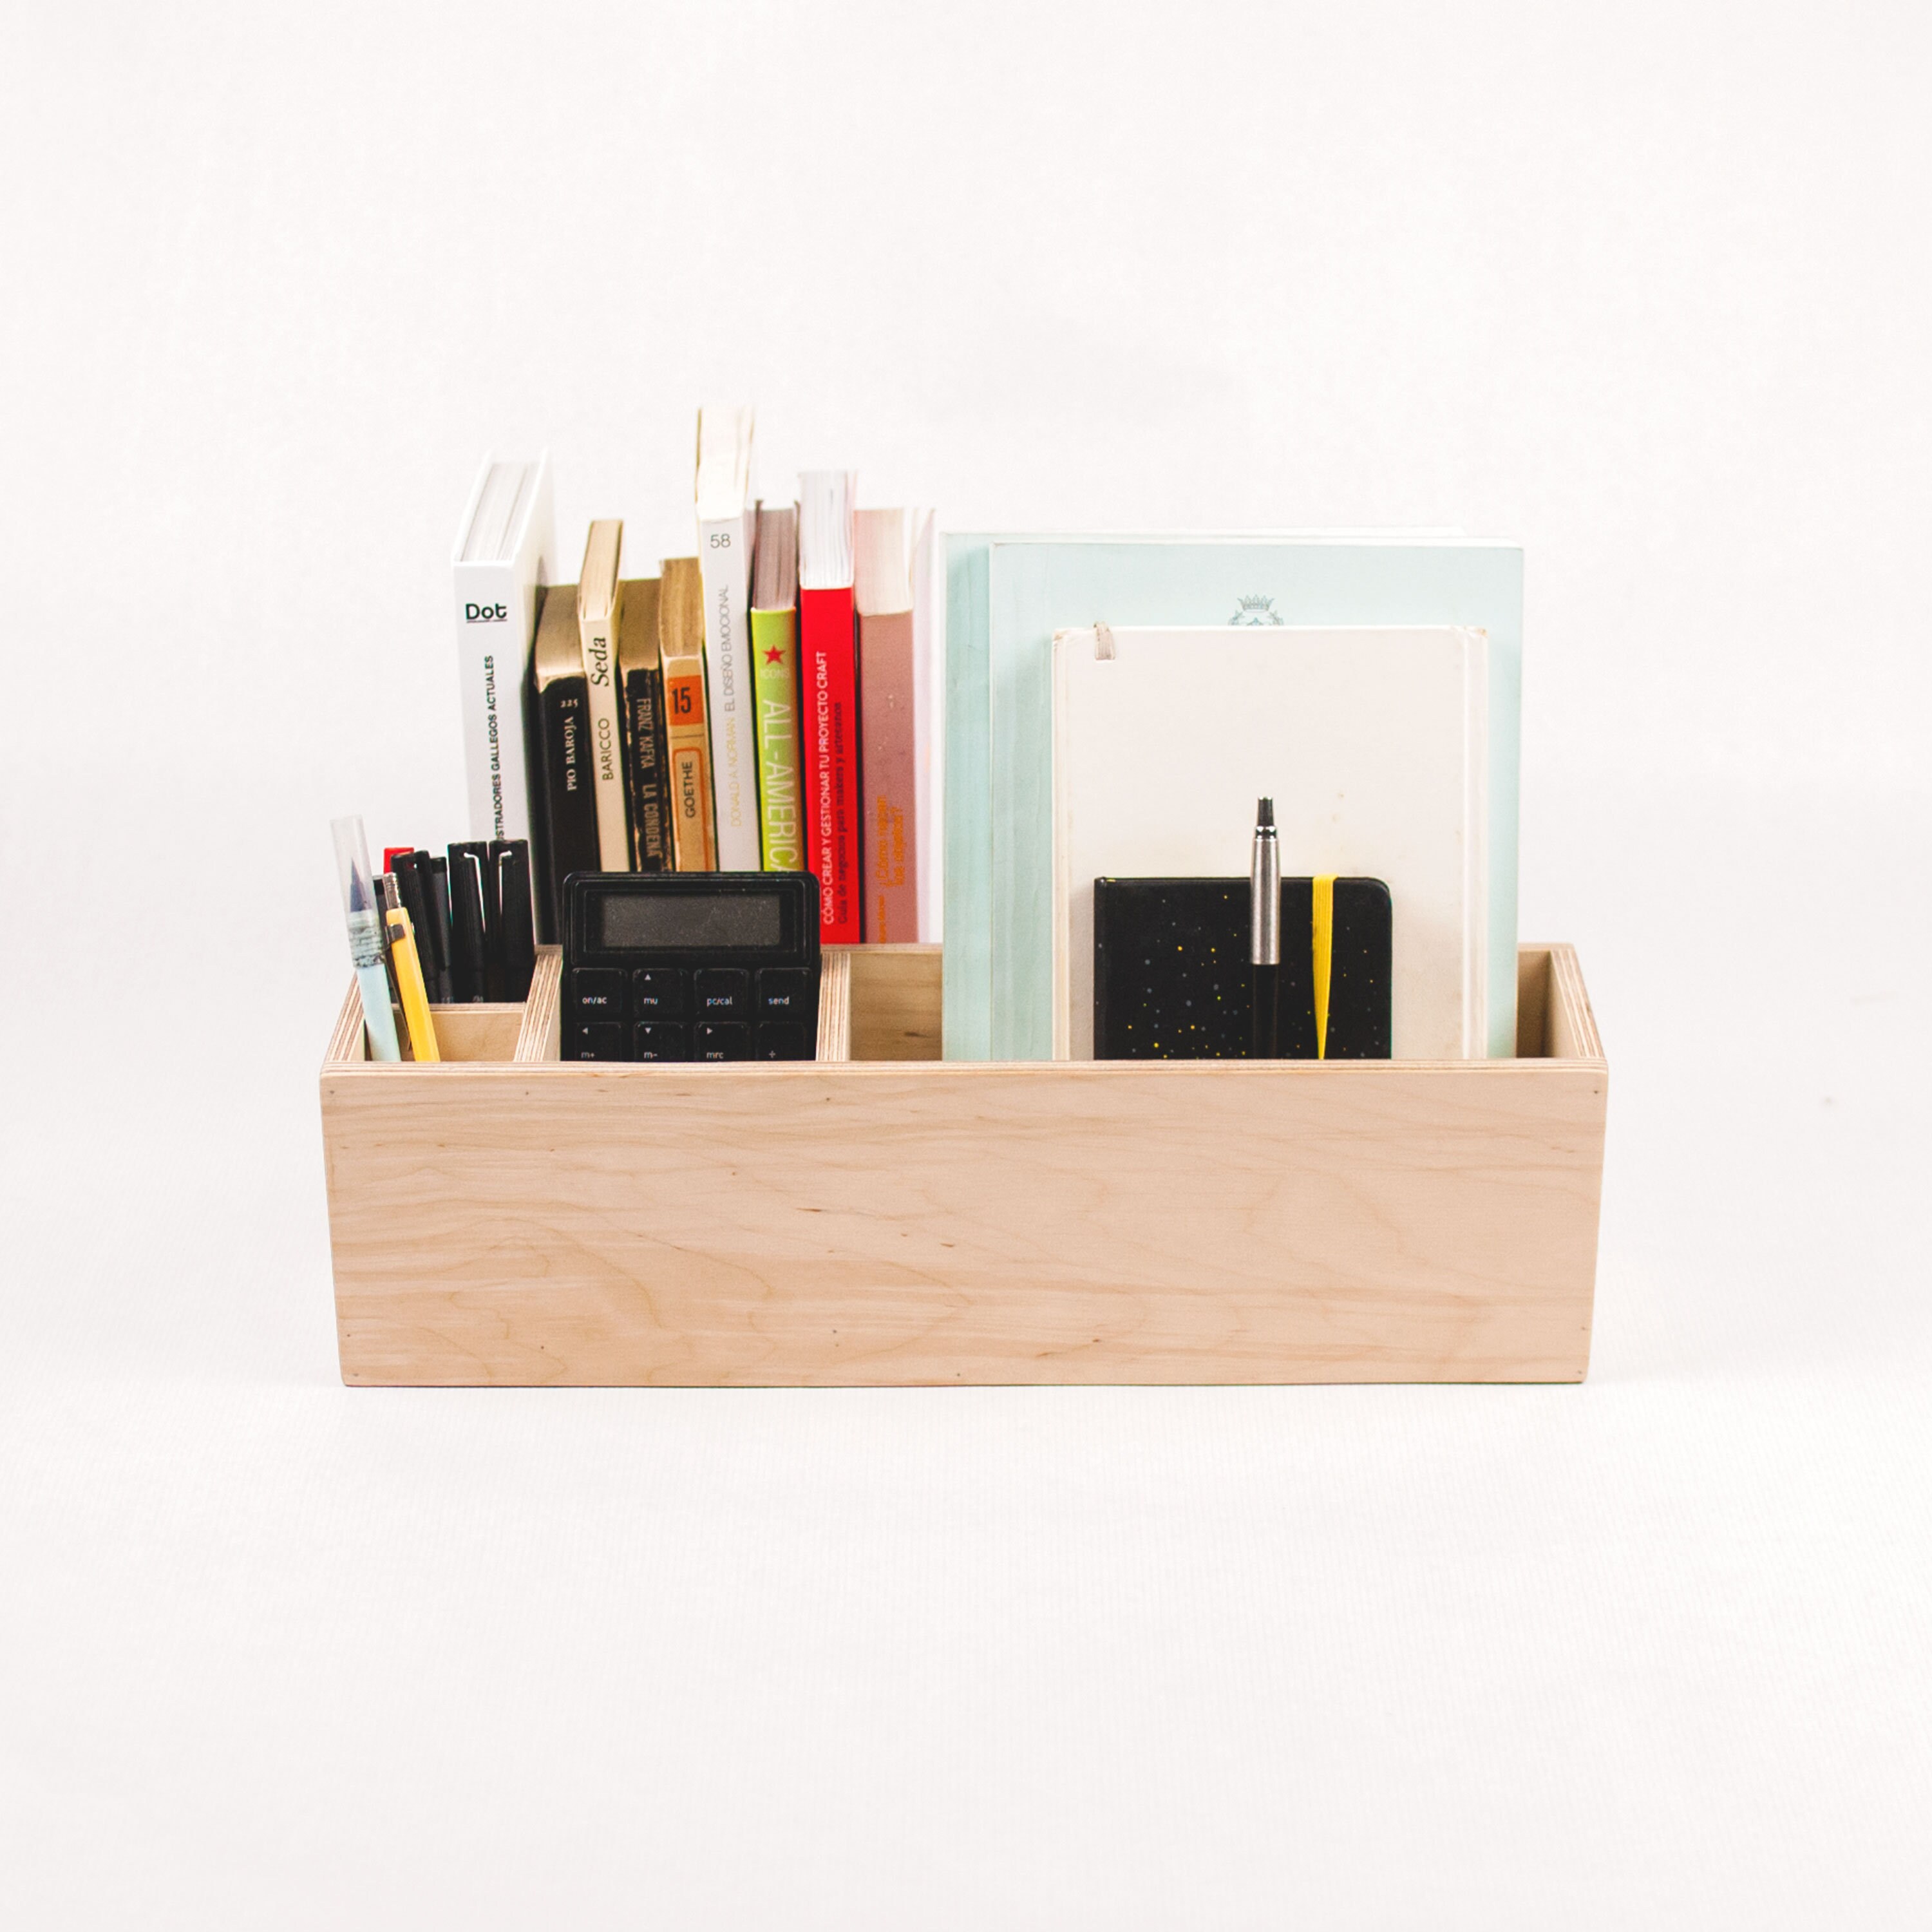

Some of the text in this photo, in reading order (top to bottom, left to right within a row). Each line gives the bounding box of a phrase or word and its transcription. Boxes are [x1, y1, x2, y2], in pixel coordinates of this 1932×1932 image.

[710, 534, 731, 548] 58
[465, 603, 507, 620] Dot
[718, 584, 732, 652] EMOCIONAL
[589, 636, 610, 687] Seda
[720, 653, 734, 696] DISEÑO
[817, 651, 828, 690] CRAFT
[484, 655, 497, 711] ACTUALES
[672, 687, 691, 715] 15
[637, 697, 655, 731] FRANZ
[724, 698, 735, 712] EL
[818, 691, 829, 753] PROYECTO
[488, 714, 500, 772] GALLEGOS
[564, 716, 577, 791] PIO BAROJA
[598, 717, 614, 781] BARICCO
[639, 735, 656, 770] KAFKA
[819, 755, 830, 768] TU
[642, 783, 657, 799] LA
[681, 761, 696, 819] GOETHE
[728, 782, 742, 827] DONALD
[820, 772, 832, 837] GESTIONAR
[822, 847, 833, 886] CREAR
[822, 887, 834, 925] CÓMO
[838, 884, 847, 897] de
[582, 997, 607, 1005] on/ac
[706, 996, 733, 1007] pc/cal
[768, 996, 790, 1005] send
